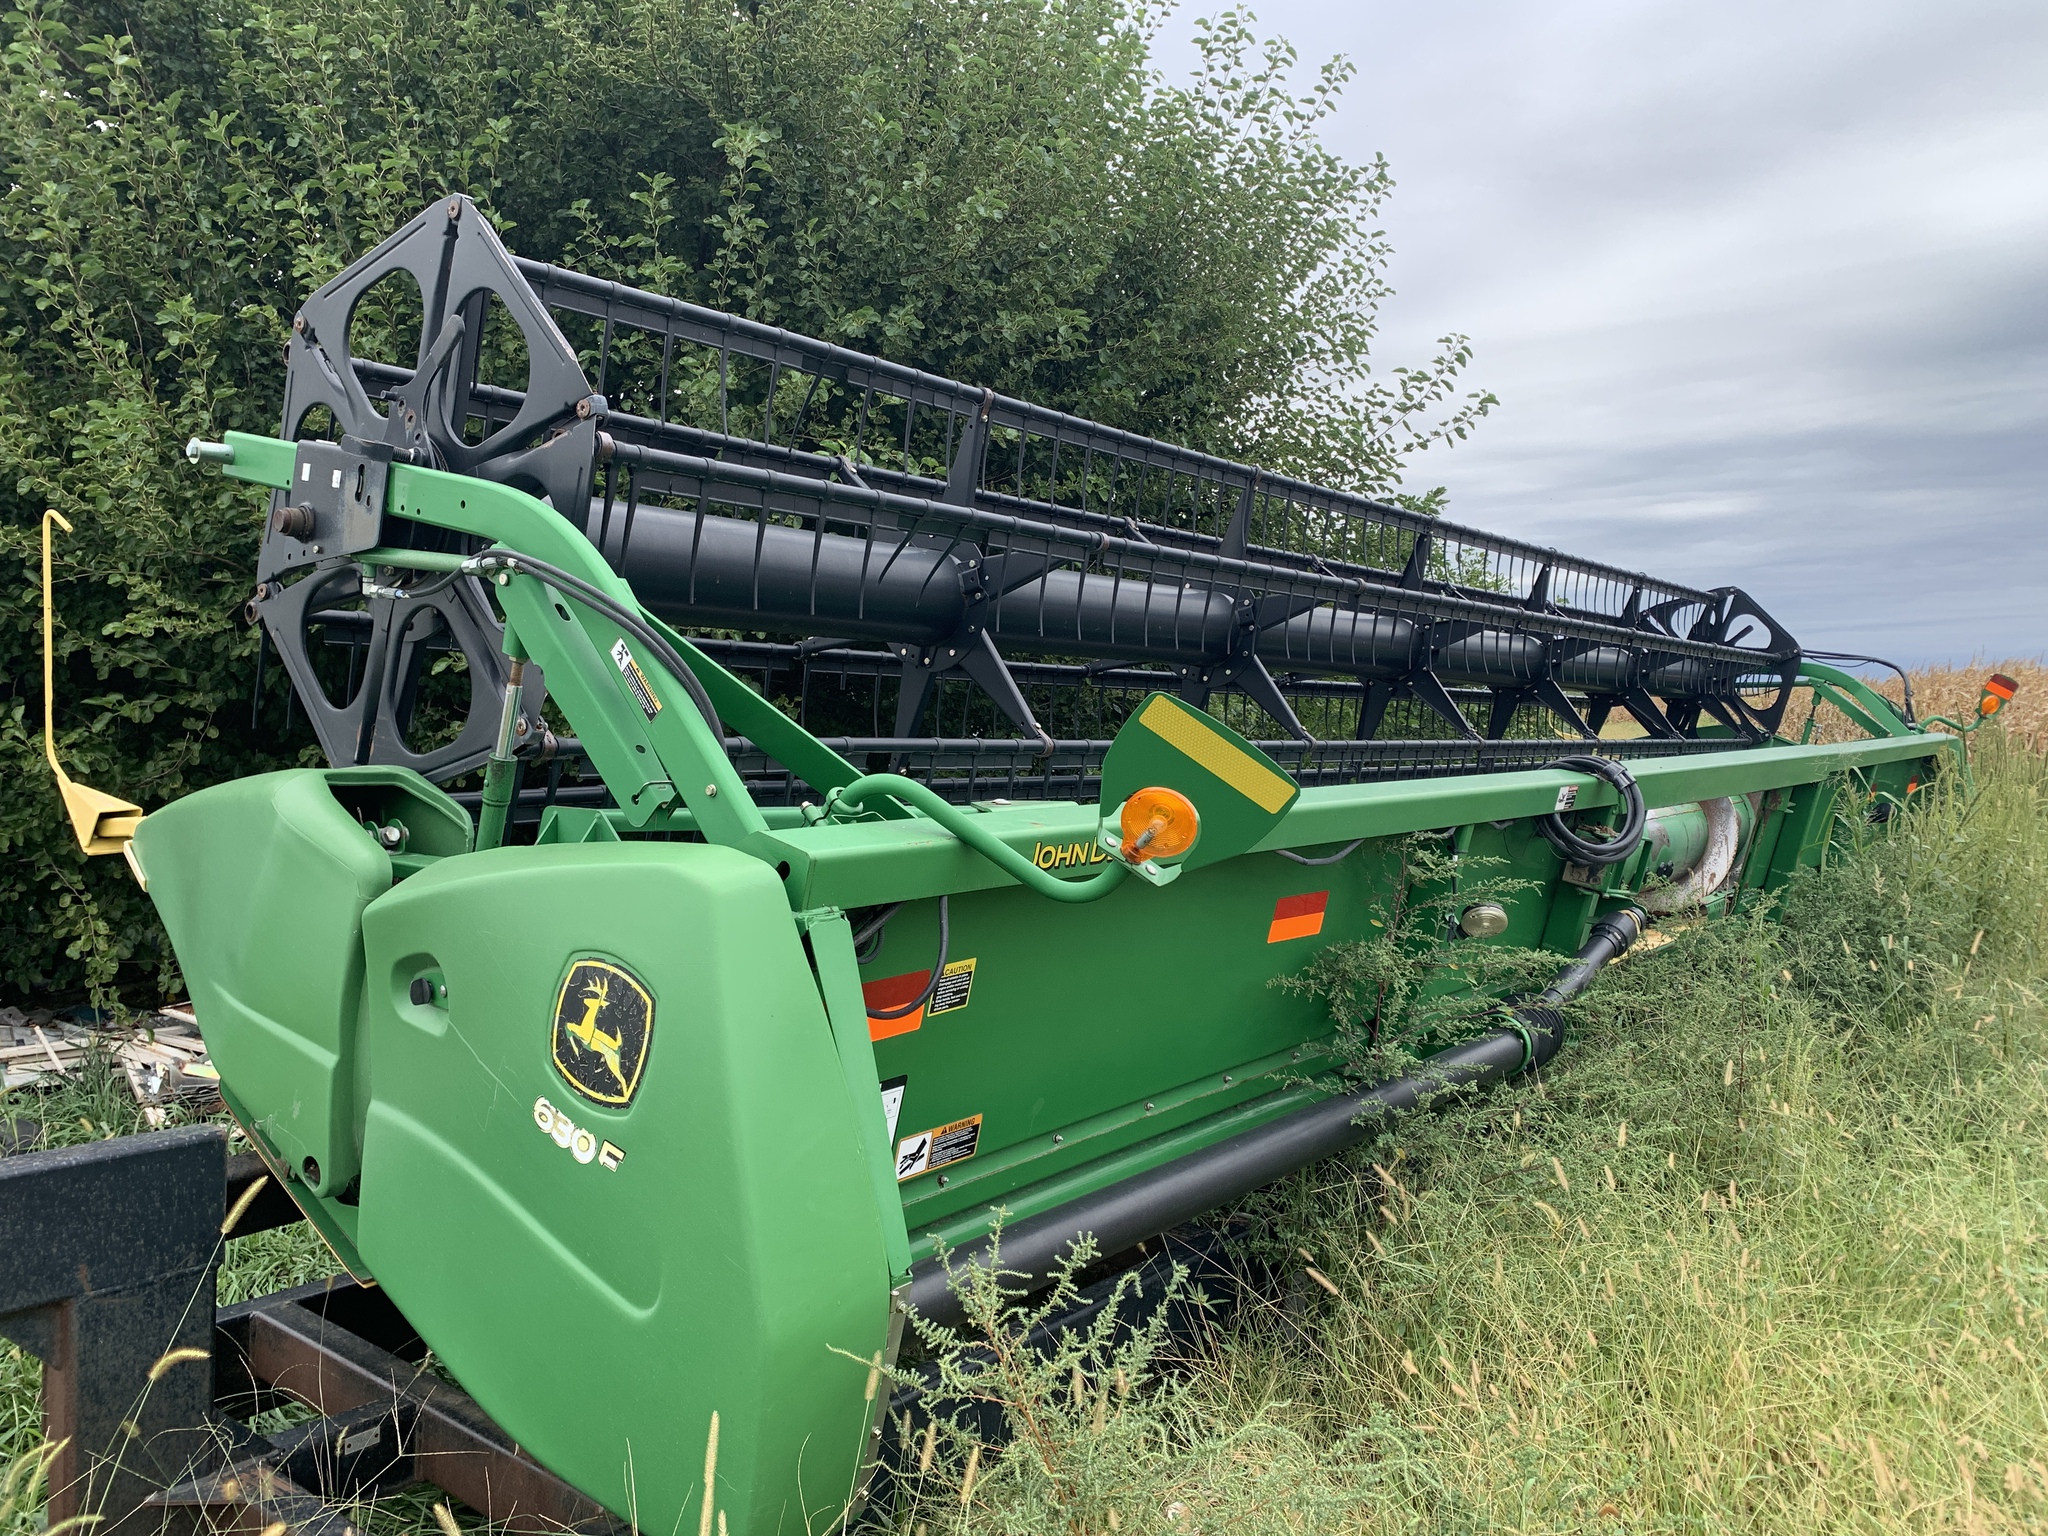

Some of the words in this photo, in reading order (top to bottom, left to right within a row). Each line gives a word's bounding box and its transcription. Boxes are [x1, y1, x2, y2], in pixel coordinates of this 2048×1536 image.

[1032, 841, 1090, 869] JOHN
[944, 963, 973, 976] CAUTION
[948, 1117, 976, 1132] WARNING
